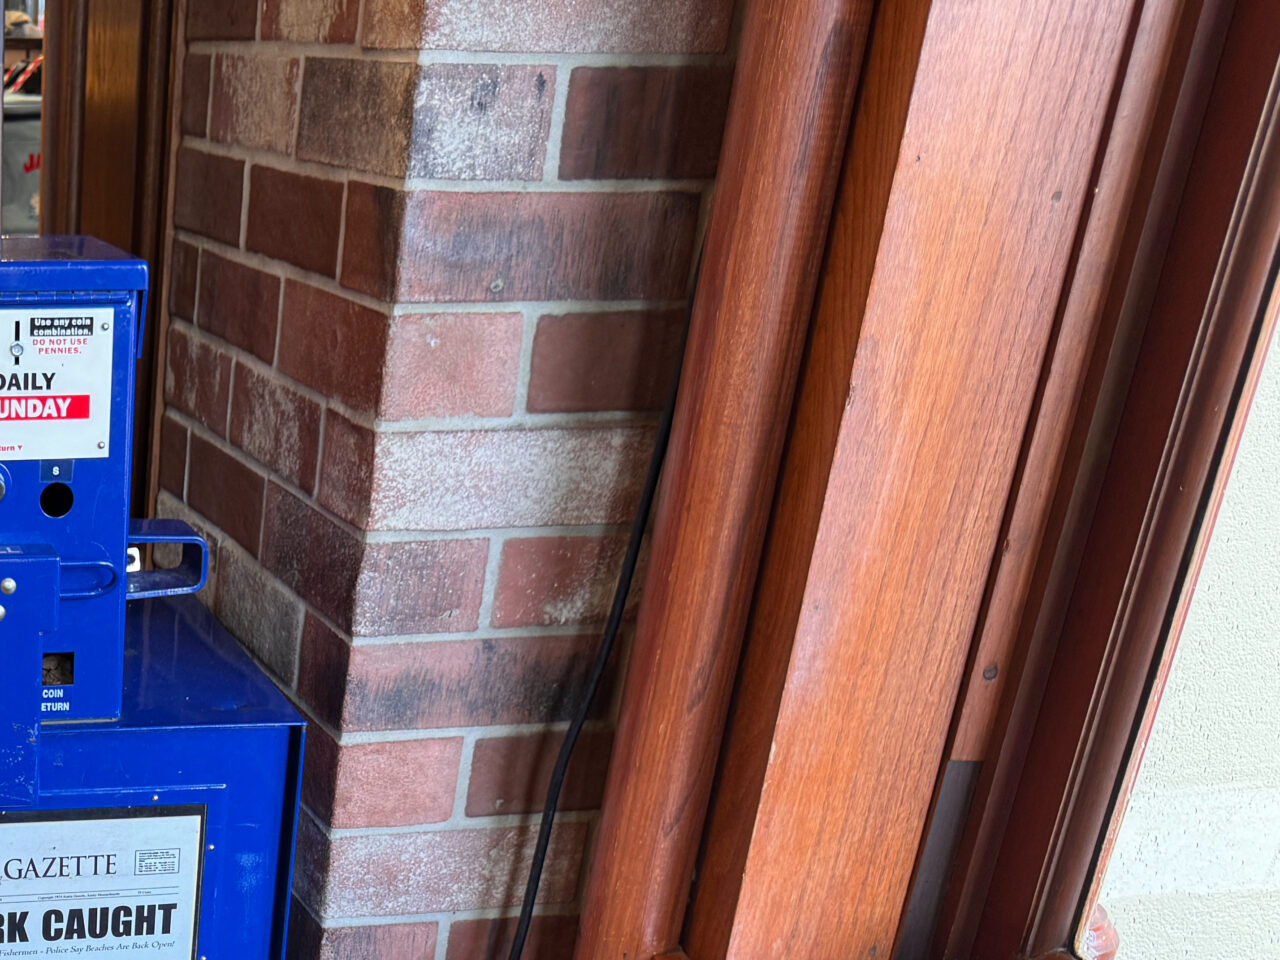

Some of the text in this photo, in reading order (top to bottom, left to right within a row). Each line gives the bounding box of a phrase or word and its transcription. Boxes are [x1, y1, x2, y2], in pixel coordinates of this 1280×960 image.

[34, 317, 91, 327] Use any coin
[33, 327, 91, 336] combination.
[48, 338, 68, 346] NOT
[38, 347, 82, 355] PENNIES.
[42, 689, 64, 698] COIN
[41, 702, 70, 711] ETURN
[3, 853, 117, 880] GAZETTE
[42, 903, 178, 941] CAUGHT
[45, 946, 68, 954] Police
[70, 946, 84, 954] Say
[86, 944, 114, 952] Beaches
[131, 941, 149, 949] Back
[151, 940, 175, 949] Open!
